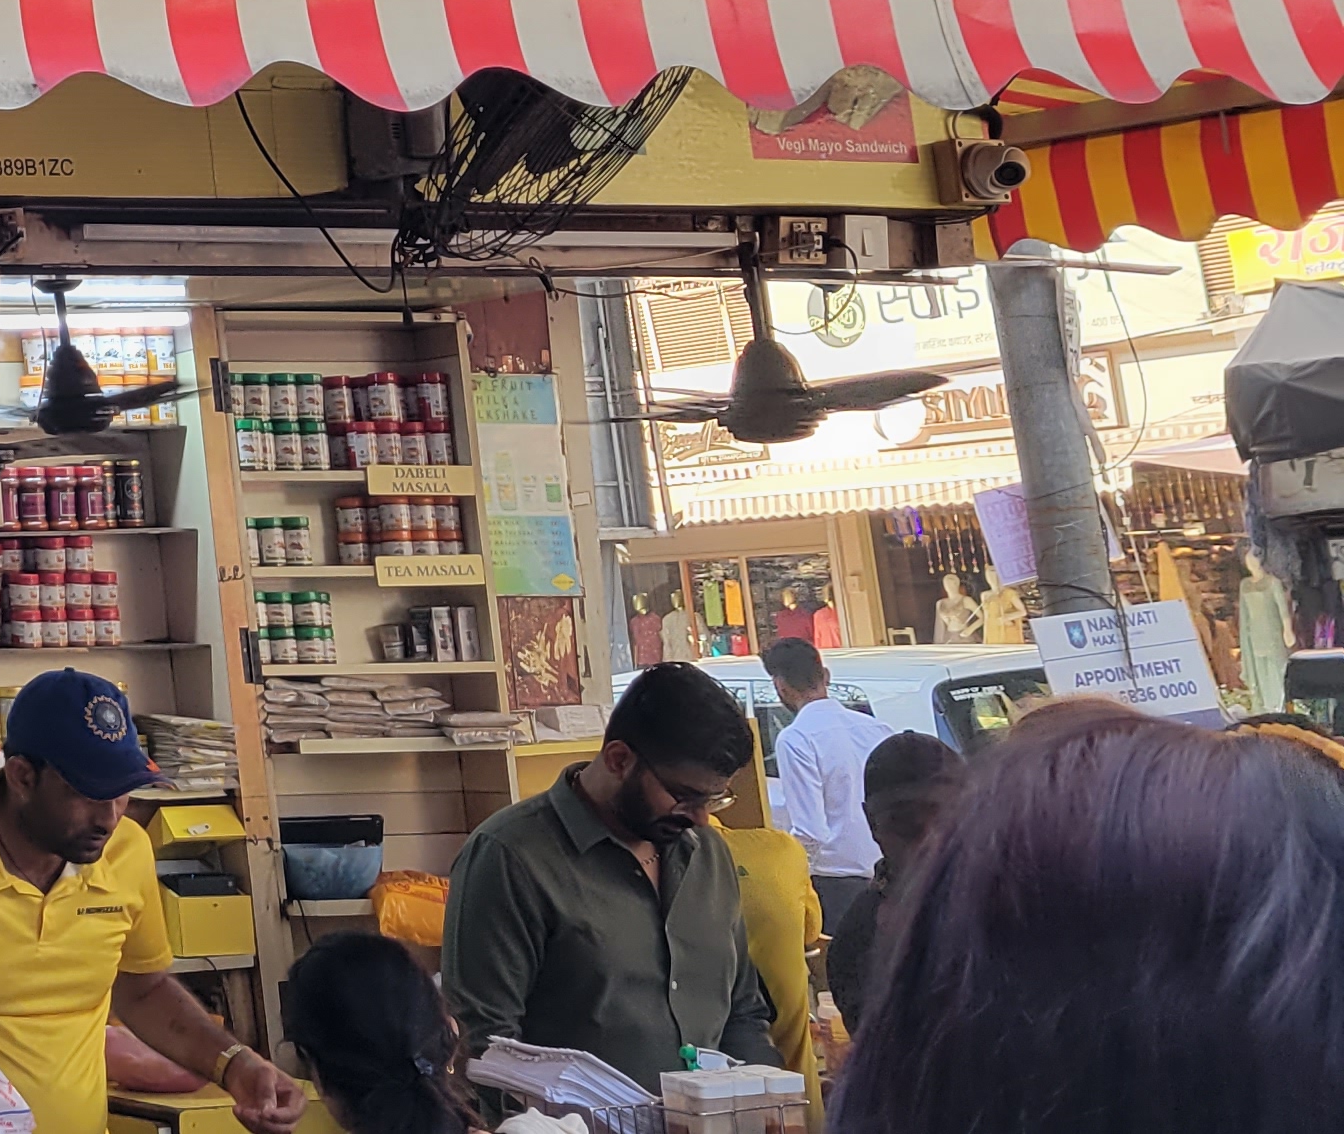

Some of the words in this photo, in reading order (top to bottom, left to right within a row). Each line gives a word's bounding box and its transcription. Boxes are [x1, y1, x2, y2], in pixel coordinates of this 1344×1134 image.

[776, 136, 805, 155] Vegi
[808, 138, 843, 157] Mayo
[846, 138, 908, 156] Sandwich
[394, 467, 446, 479] DABELI
[392, 481, 451, 493] MASALA
[384, 565, 413, 578] TEA
[416, 564, 476, 577] MASALA
[1092, 633, 1116, 648] MAX
[1074, 658, 1182, 688] APPOINTMENT
[1159, 680, 1198, 699] 0000
